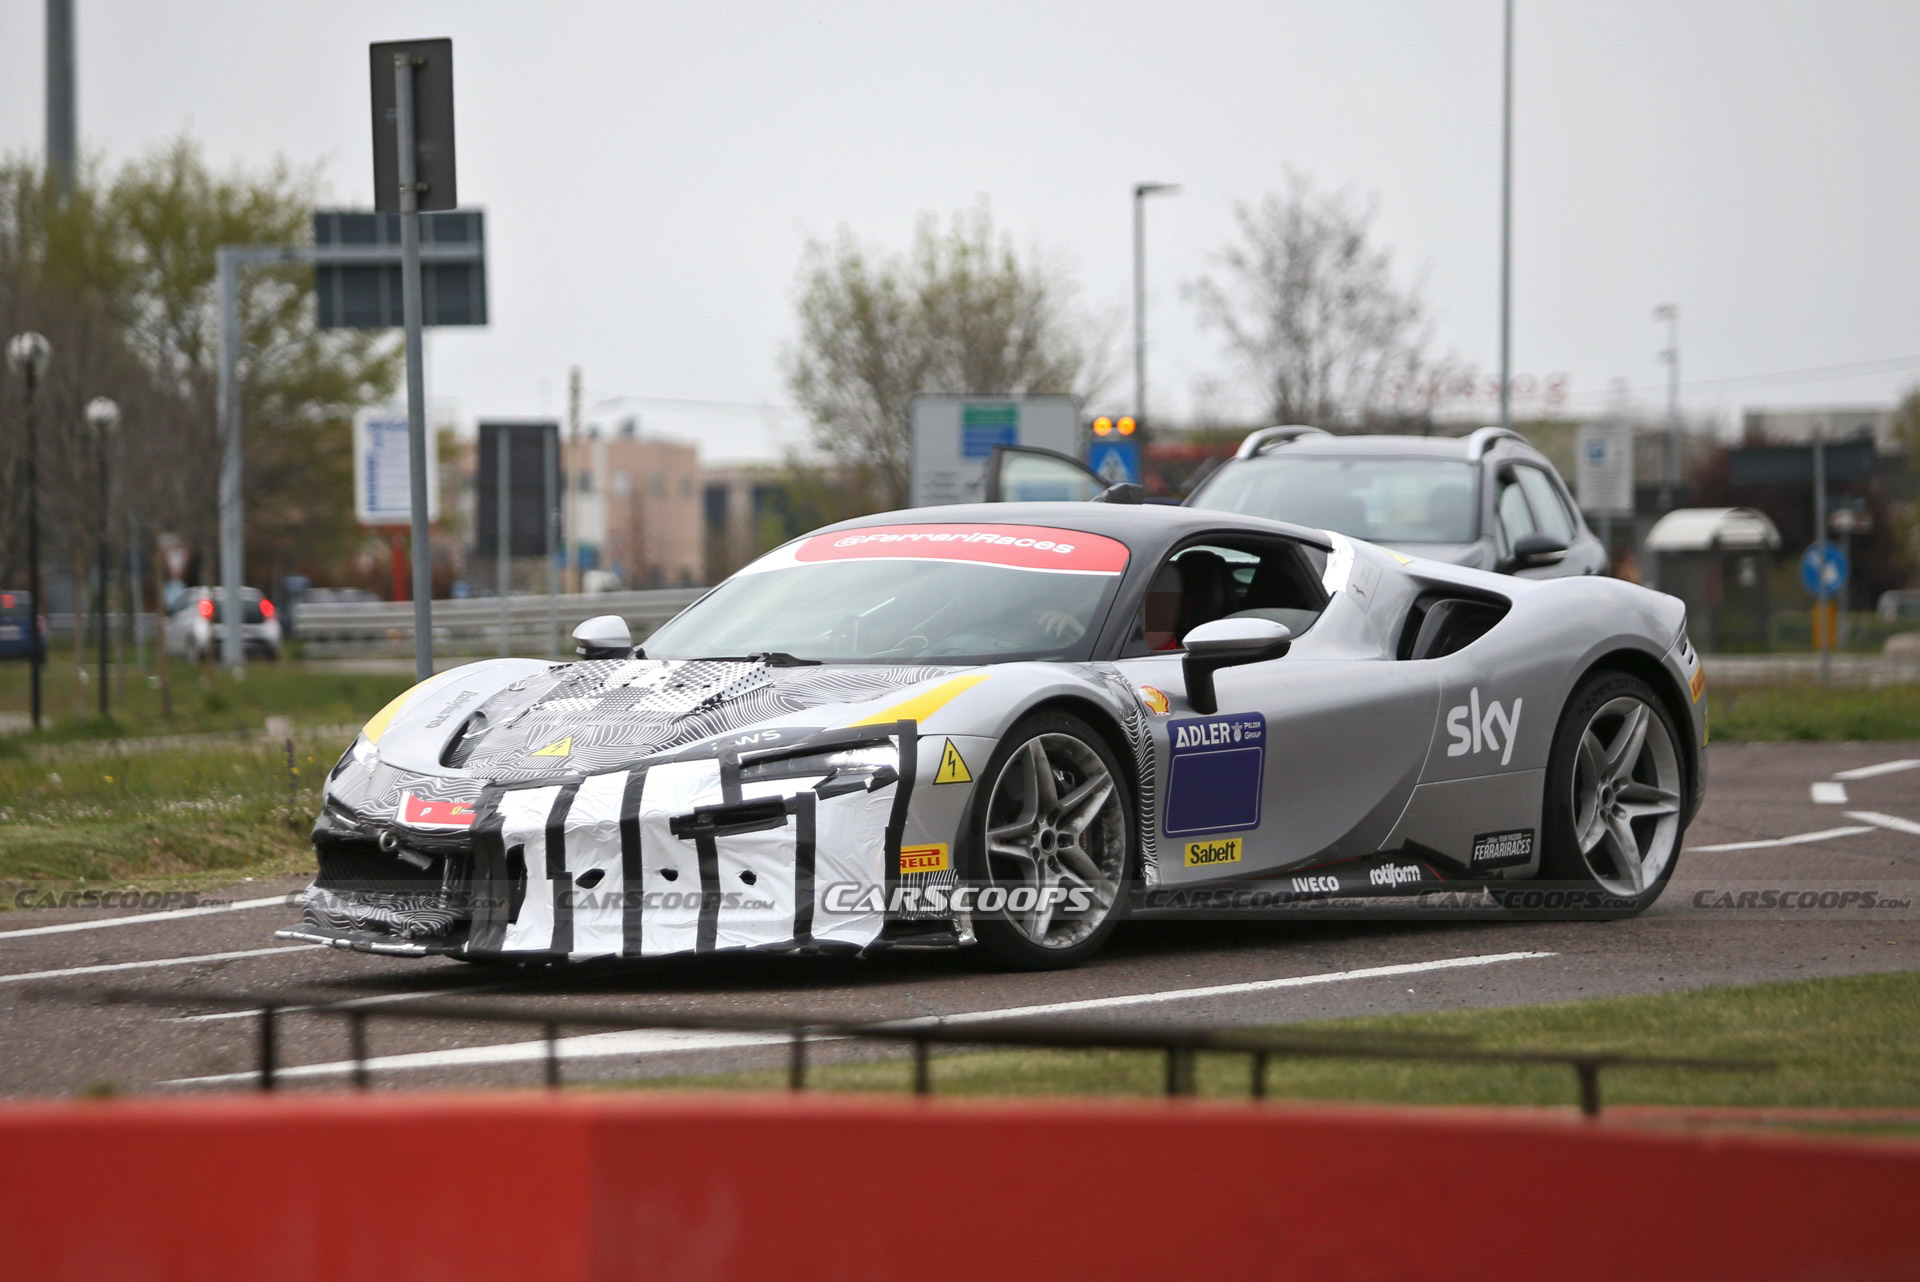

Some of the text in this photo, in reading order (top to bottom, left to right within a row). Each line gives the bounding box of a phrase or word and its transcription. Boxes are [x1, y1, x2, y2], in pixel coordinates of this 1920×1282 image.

[833, 532, 1075, 554] @FerrariRaces
[1175, 722, 1231, 748] ADLER
[1446, 686, 1523, 766] sky
[1190, 841, 1236, 865] Sabelt
[1474, 838, 1532, 861] FERRARIRACES
[1292, 875, 1340, 892] IVECO
[1369, 862, 1422, 888] rotiform
